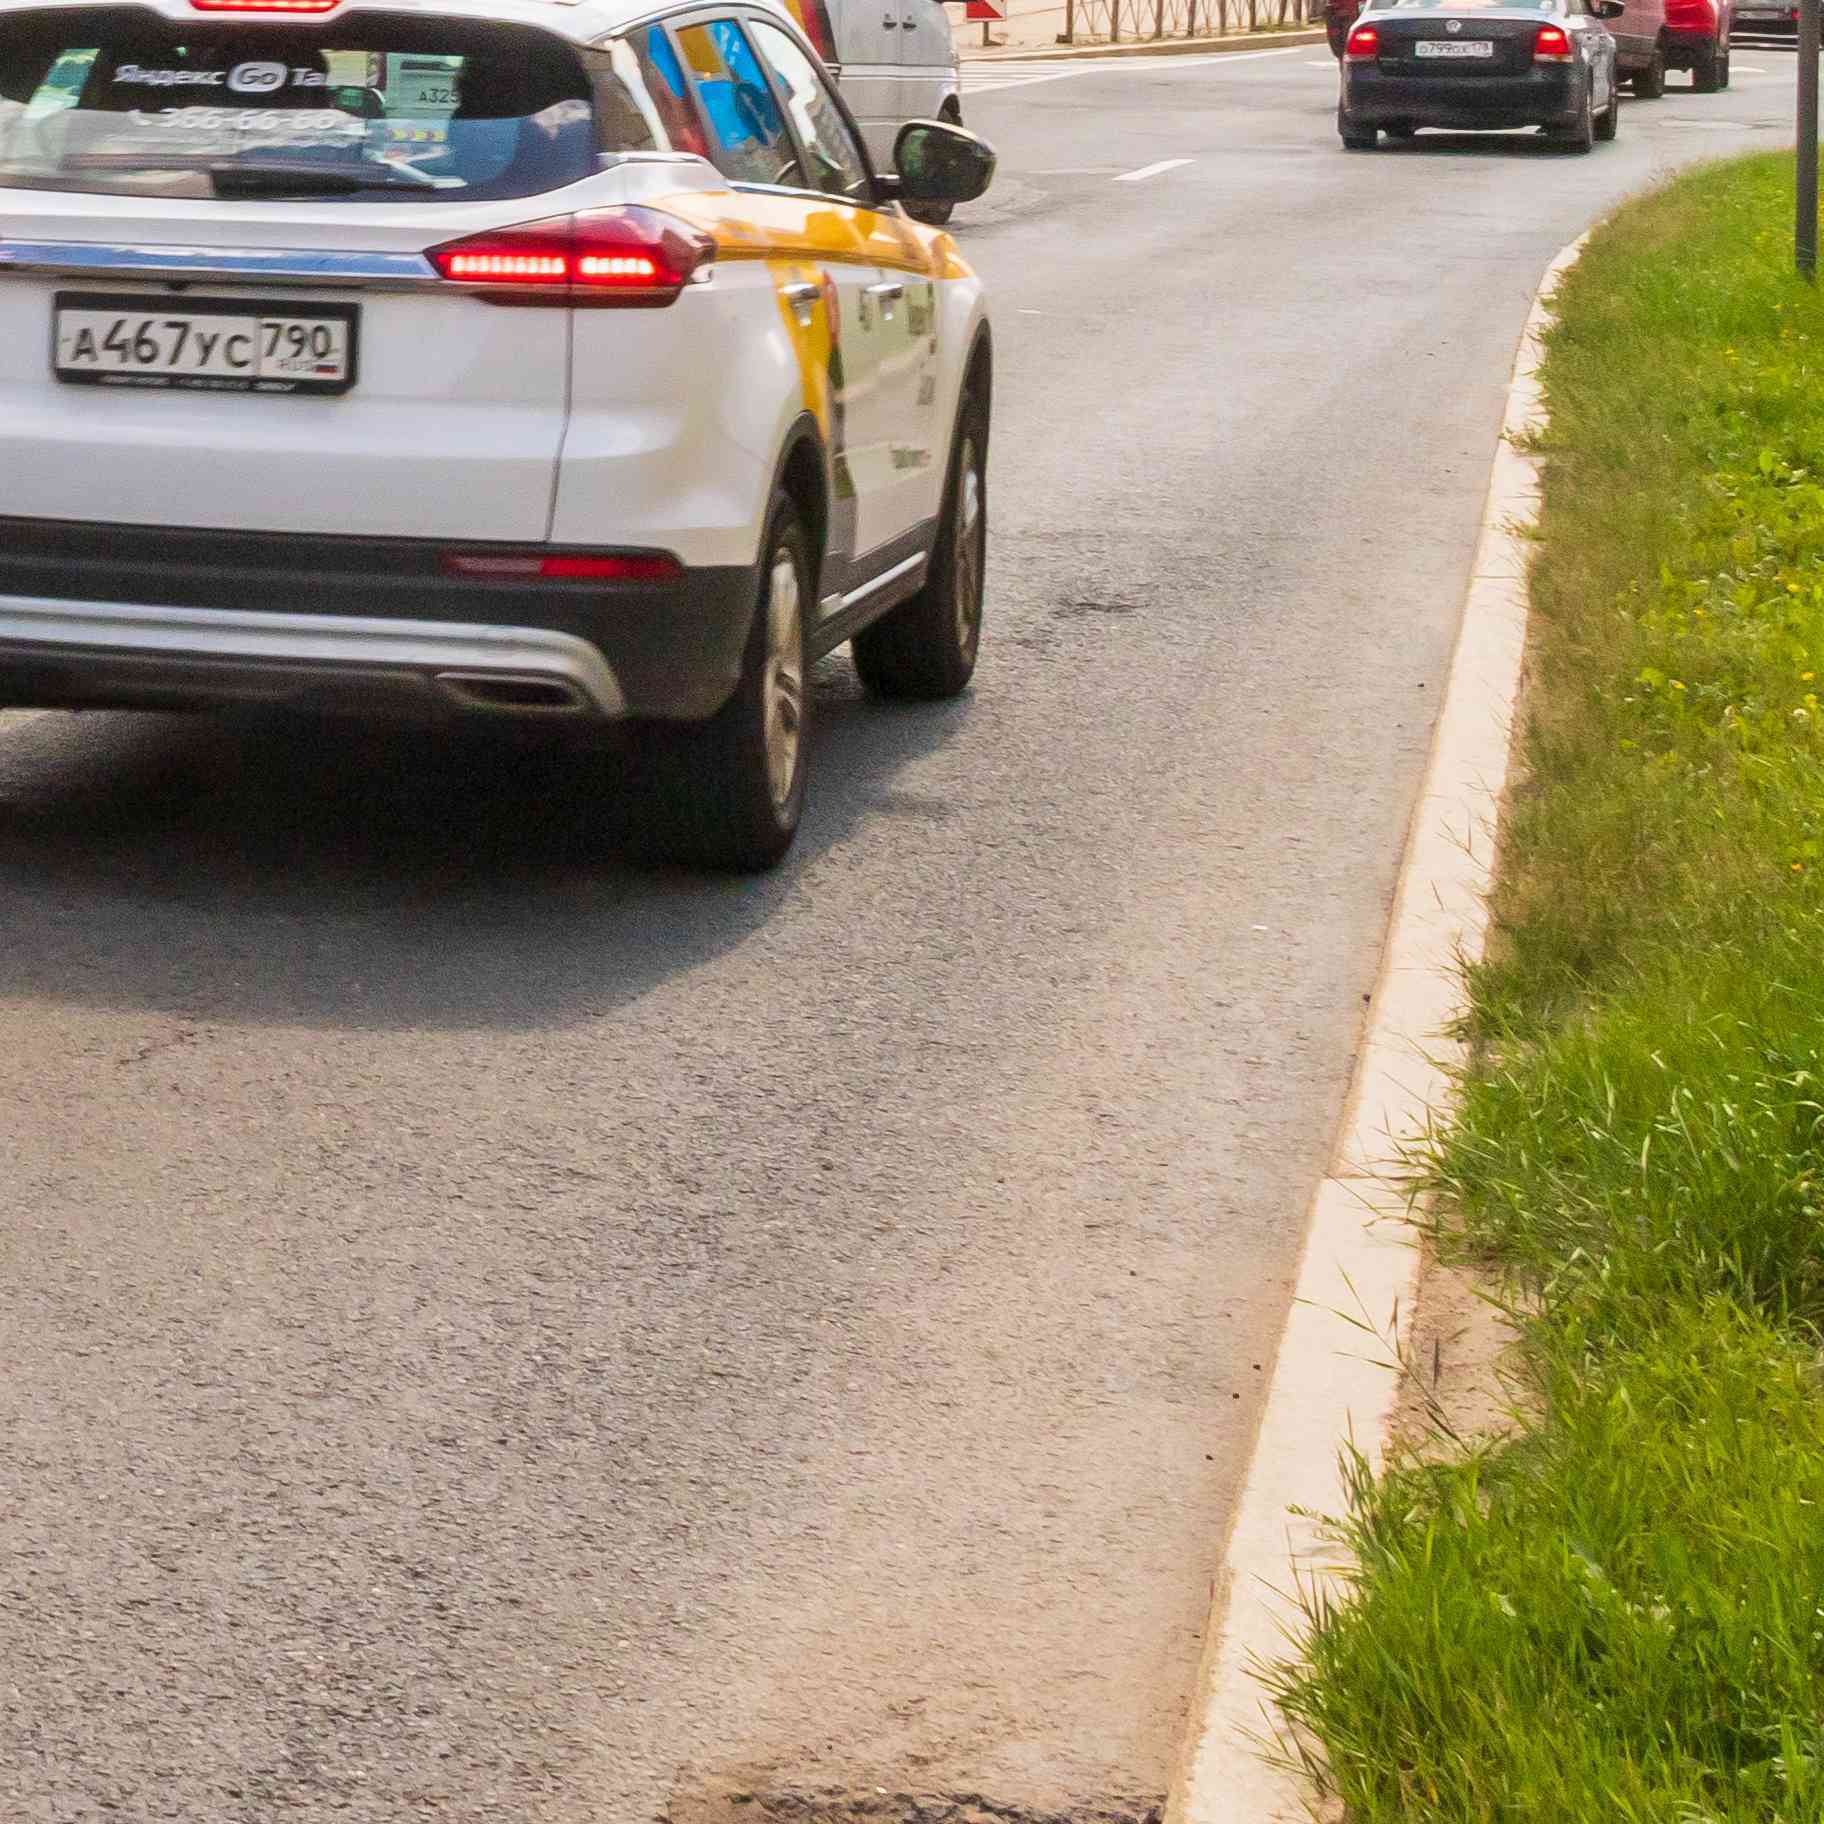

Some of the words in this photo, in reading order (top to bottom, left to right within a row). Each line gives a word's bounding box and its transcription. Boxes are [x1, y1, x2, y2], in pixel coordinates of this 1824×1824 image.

[112, 64, 226, 87] Яндекс
[239, 68, 278, 87] Go
[71, 318, 252, 368] А467УС
[261, 322, 332, 358] 790
